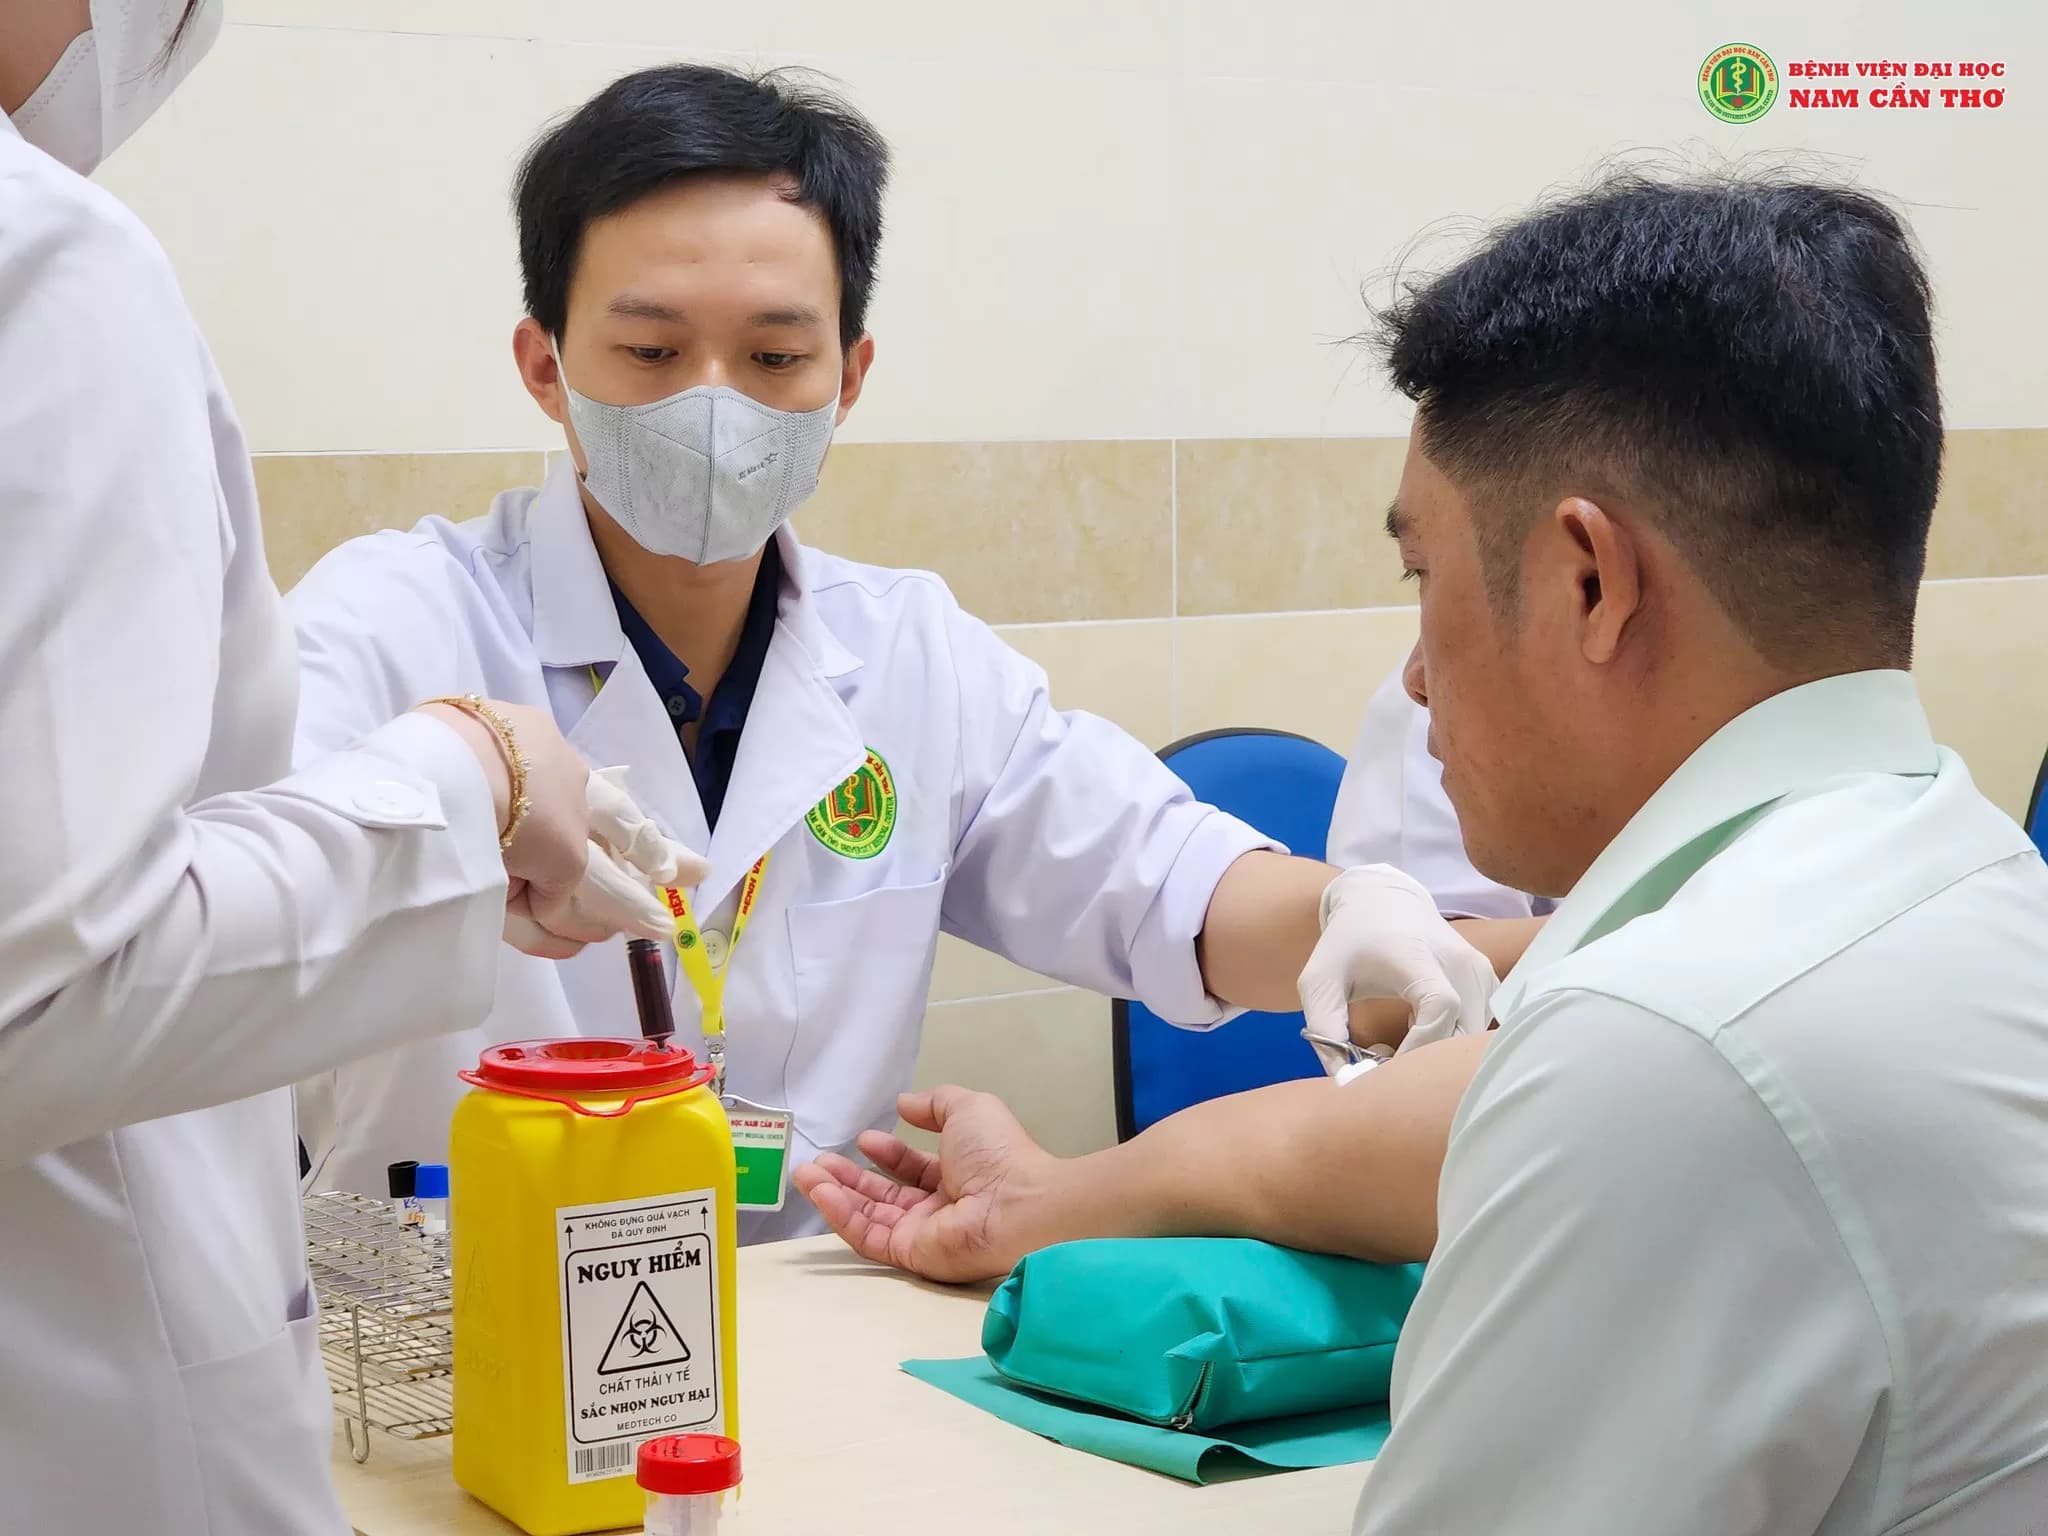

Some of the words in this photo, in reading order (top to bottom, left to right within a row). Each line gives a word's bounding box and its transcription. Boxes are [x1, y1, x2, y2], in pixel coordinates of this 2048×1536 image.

[585, 1218, 617, 1231] KHÔNG
[619, 1215, 645, 1227] ĐỰNG
[647, 1211, 665, 1223] QUÁ
[668, 1208, 690, 1219] VẠCH
[626, 1227, 643, 1238] QUY
[646, 1224, 667, 1235] ĐỊNH
[577, 1257, 642, 1284] NGUY
[648, 1240, 701, 1274] HIỂM
[599, 1376, 632, 1395] CHẤT
[635, 1371, 662, 1389] THẢI
[665, 1373, 673, 1384] Y
[676, 1365, 691, 1381] TẾ
[581, 1401, 607, 1420] SẮC
[610, 1399, 647, 1415] NHỌN
[650, 1392, 686, 1408] NGUY
[688, 1387, 711, 1403] HẠI
[617, 1416, 662, 1431] MEDTECH
[664, 1414, 677, 1423] CO
